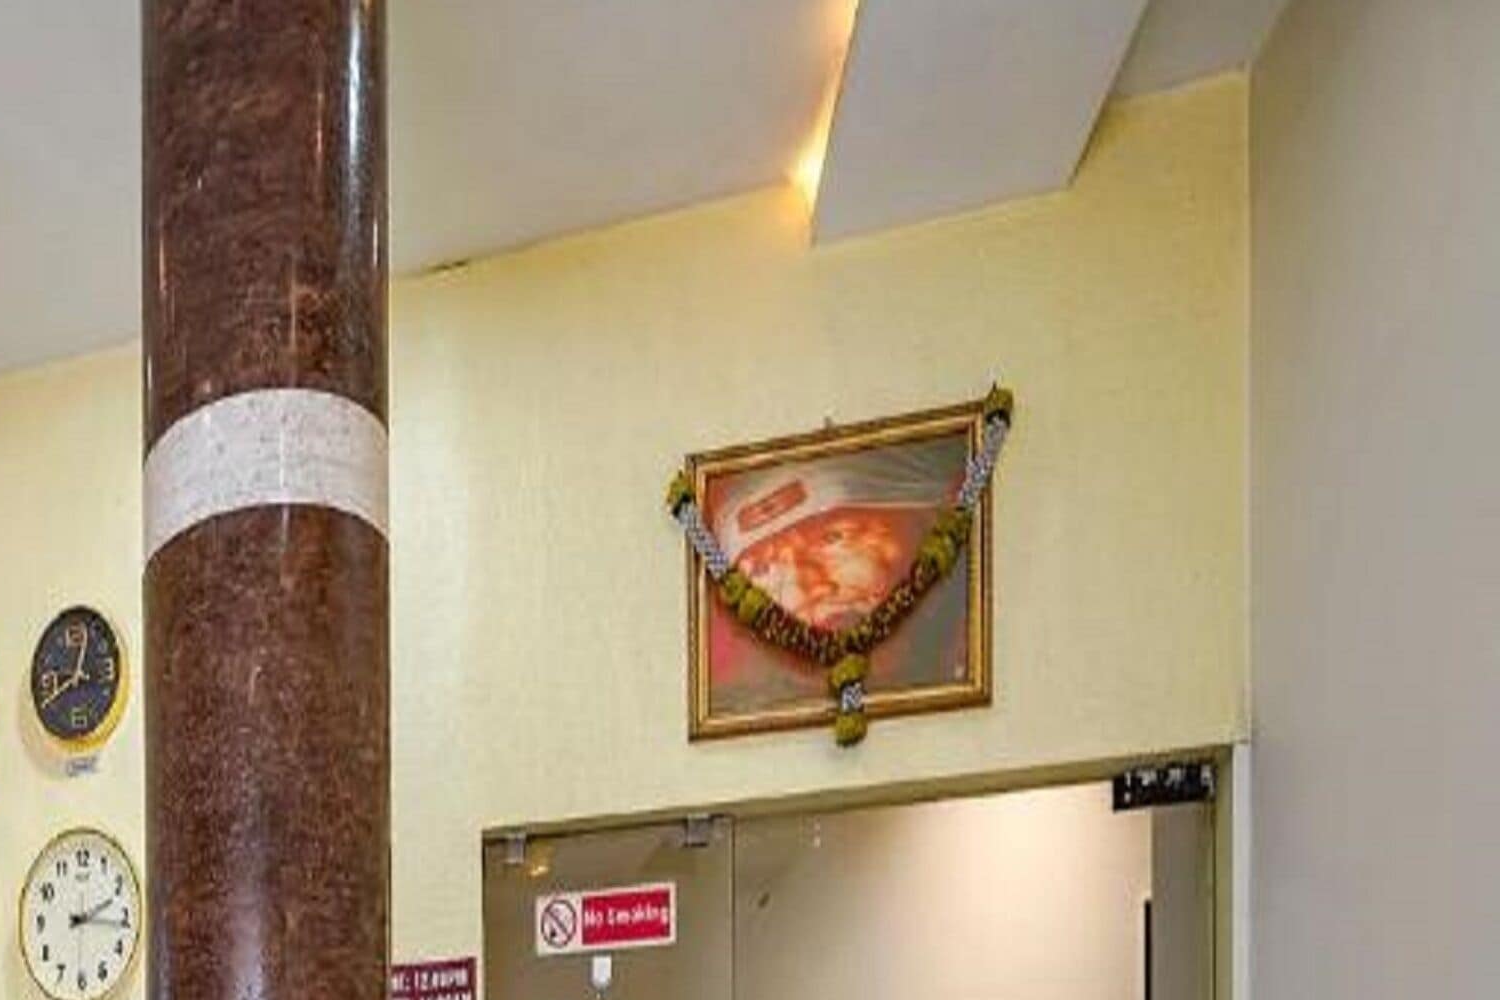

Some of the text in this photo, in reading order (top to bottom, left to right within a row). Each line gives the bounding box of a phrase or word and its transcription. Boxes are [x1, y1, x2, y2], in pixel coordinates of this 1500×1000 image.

[56, 861, 68, 876] 11
[75, 849, 90, 868] 12
[100, 856, 107, 874] 1
[40, 882, 55, 902] 10
[114, 874, 123, 896] 2
[36, 913, 46, 934] 9
[584, 902, 669, 928] No Smoking
[56, 963, 66, 984] 7
[77, 971, 88, 991] 6
